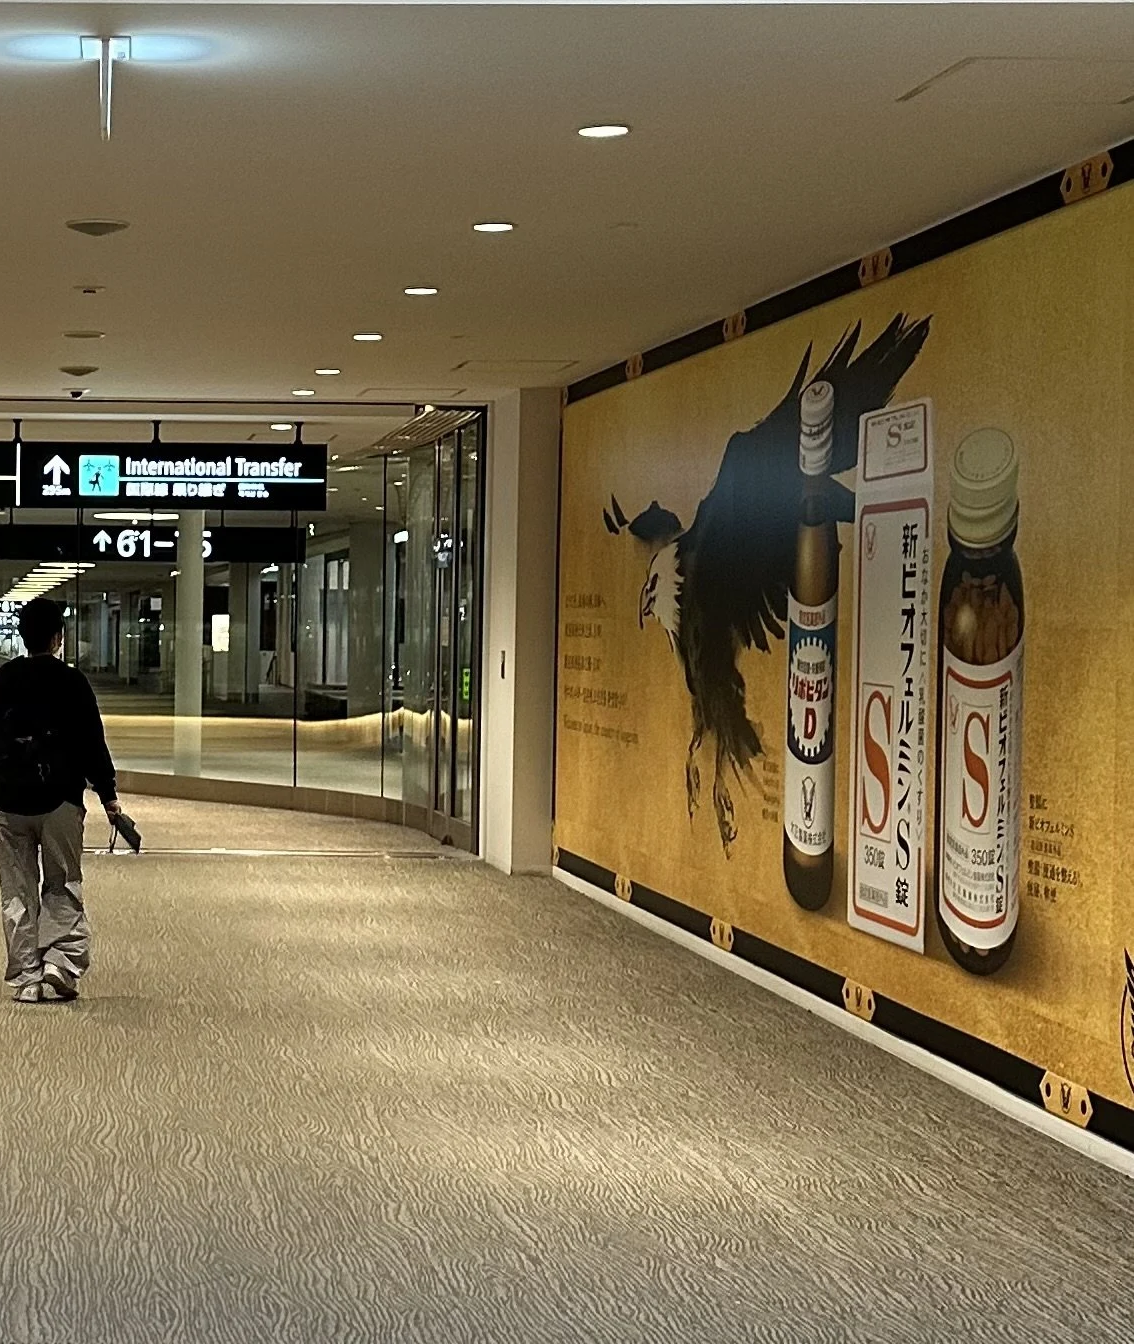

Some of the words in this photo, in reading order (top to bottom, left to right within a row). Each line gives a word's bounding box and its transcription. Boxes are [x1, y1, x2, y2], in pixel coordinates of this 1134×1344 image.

[125, 456, 231, 477] International
[235, 457, 302, 478] Transfer
[803, 707, 818, 741] D
[862, 689, 893, 835] S
[962, 711, 990, 828] S
